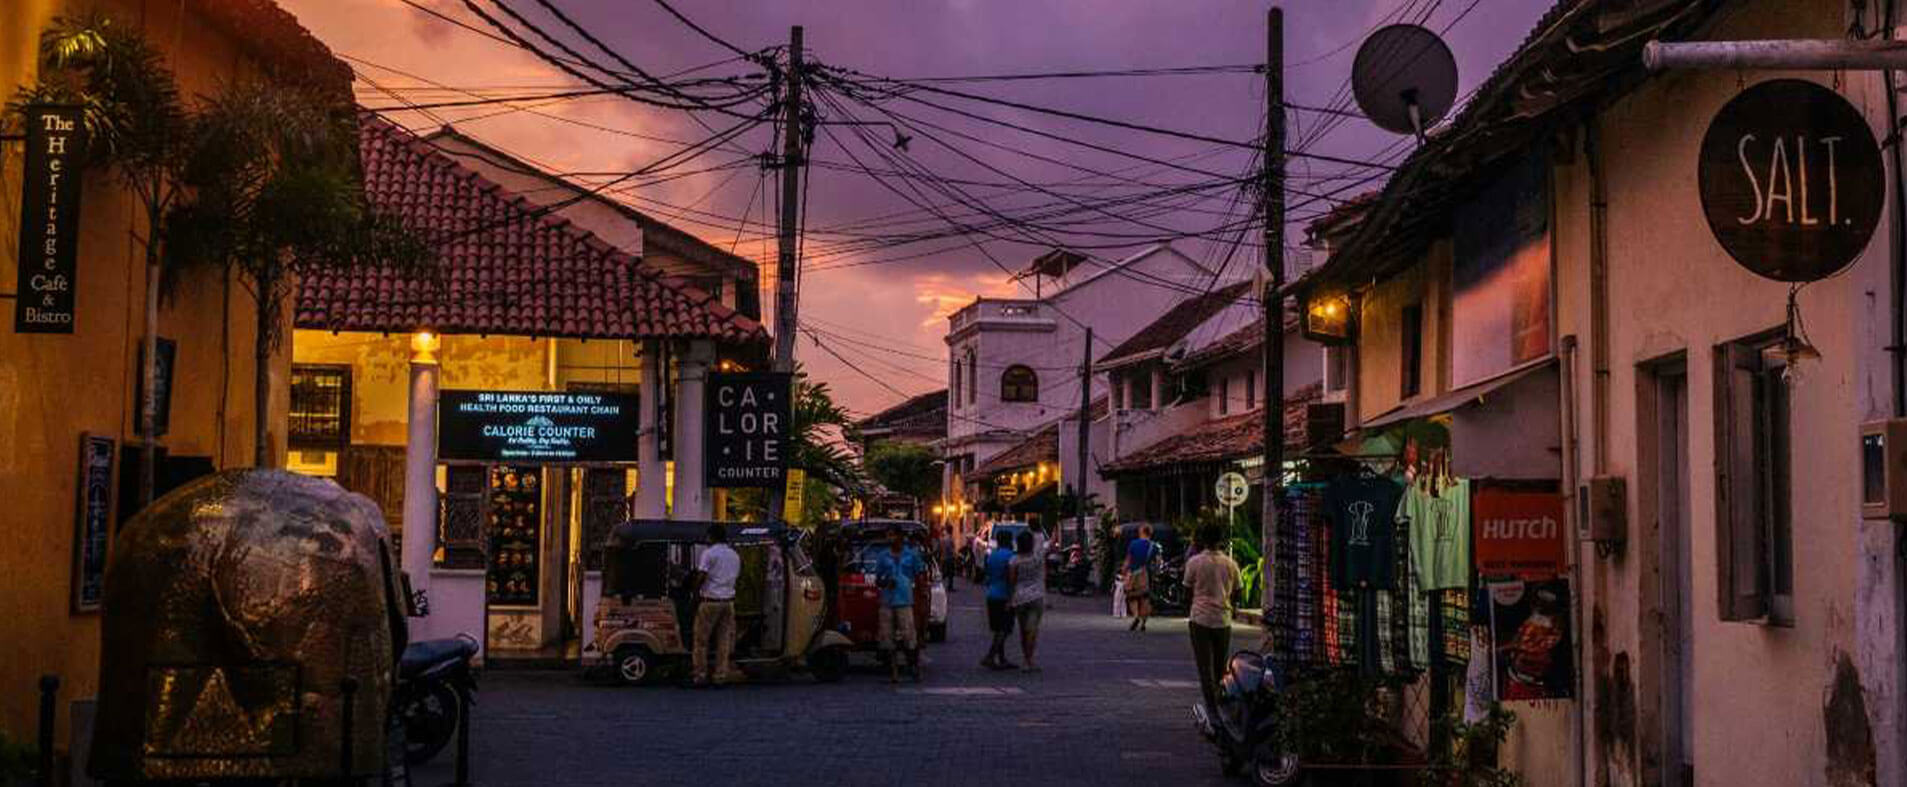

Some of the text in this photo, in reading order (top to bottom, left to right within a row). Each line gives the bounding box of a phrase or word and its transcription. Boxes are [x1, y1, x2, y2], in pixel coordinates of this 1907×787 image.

[42, 115, 75, 131] The
[1737, 133, 1852, 226] SALT.
[45, 137, 66, 270] Heritage
[42, 294, 55, 306] &
[25, 307, 71, 323] Bistro
[478, 393, 602, 405] SRI LANKA'S FIRST & ONLY
[460, 403, 620, 415] HEALTH FOOD RESTAURANT CHAIN
[483, 425, 596, 439] CALORIE COUNTER
[718, 466, 780, 479] COUNTER
